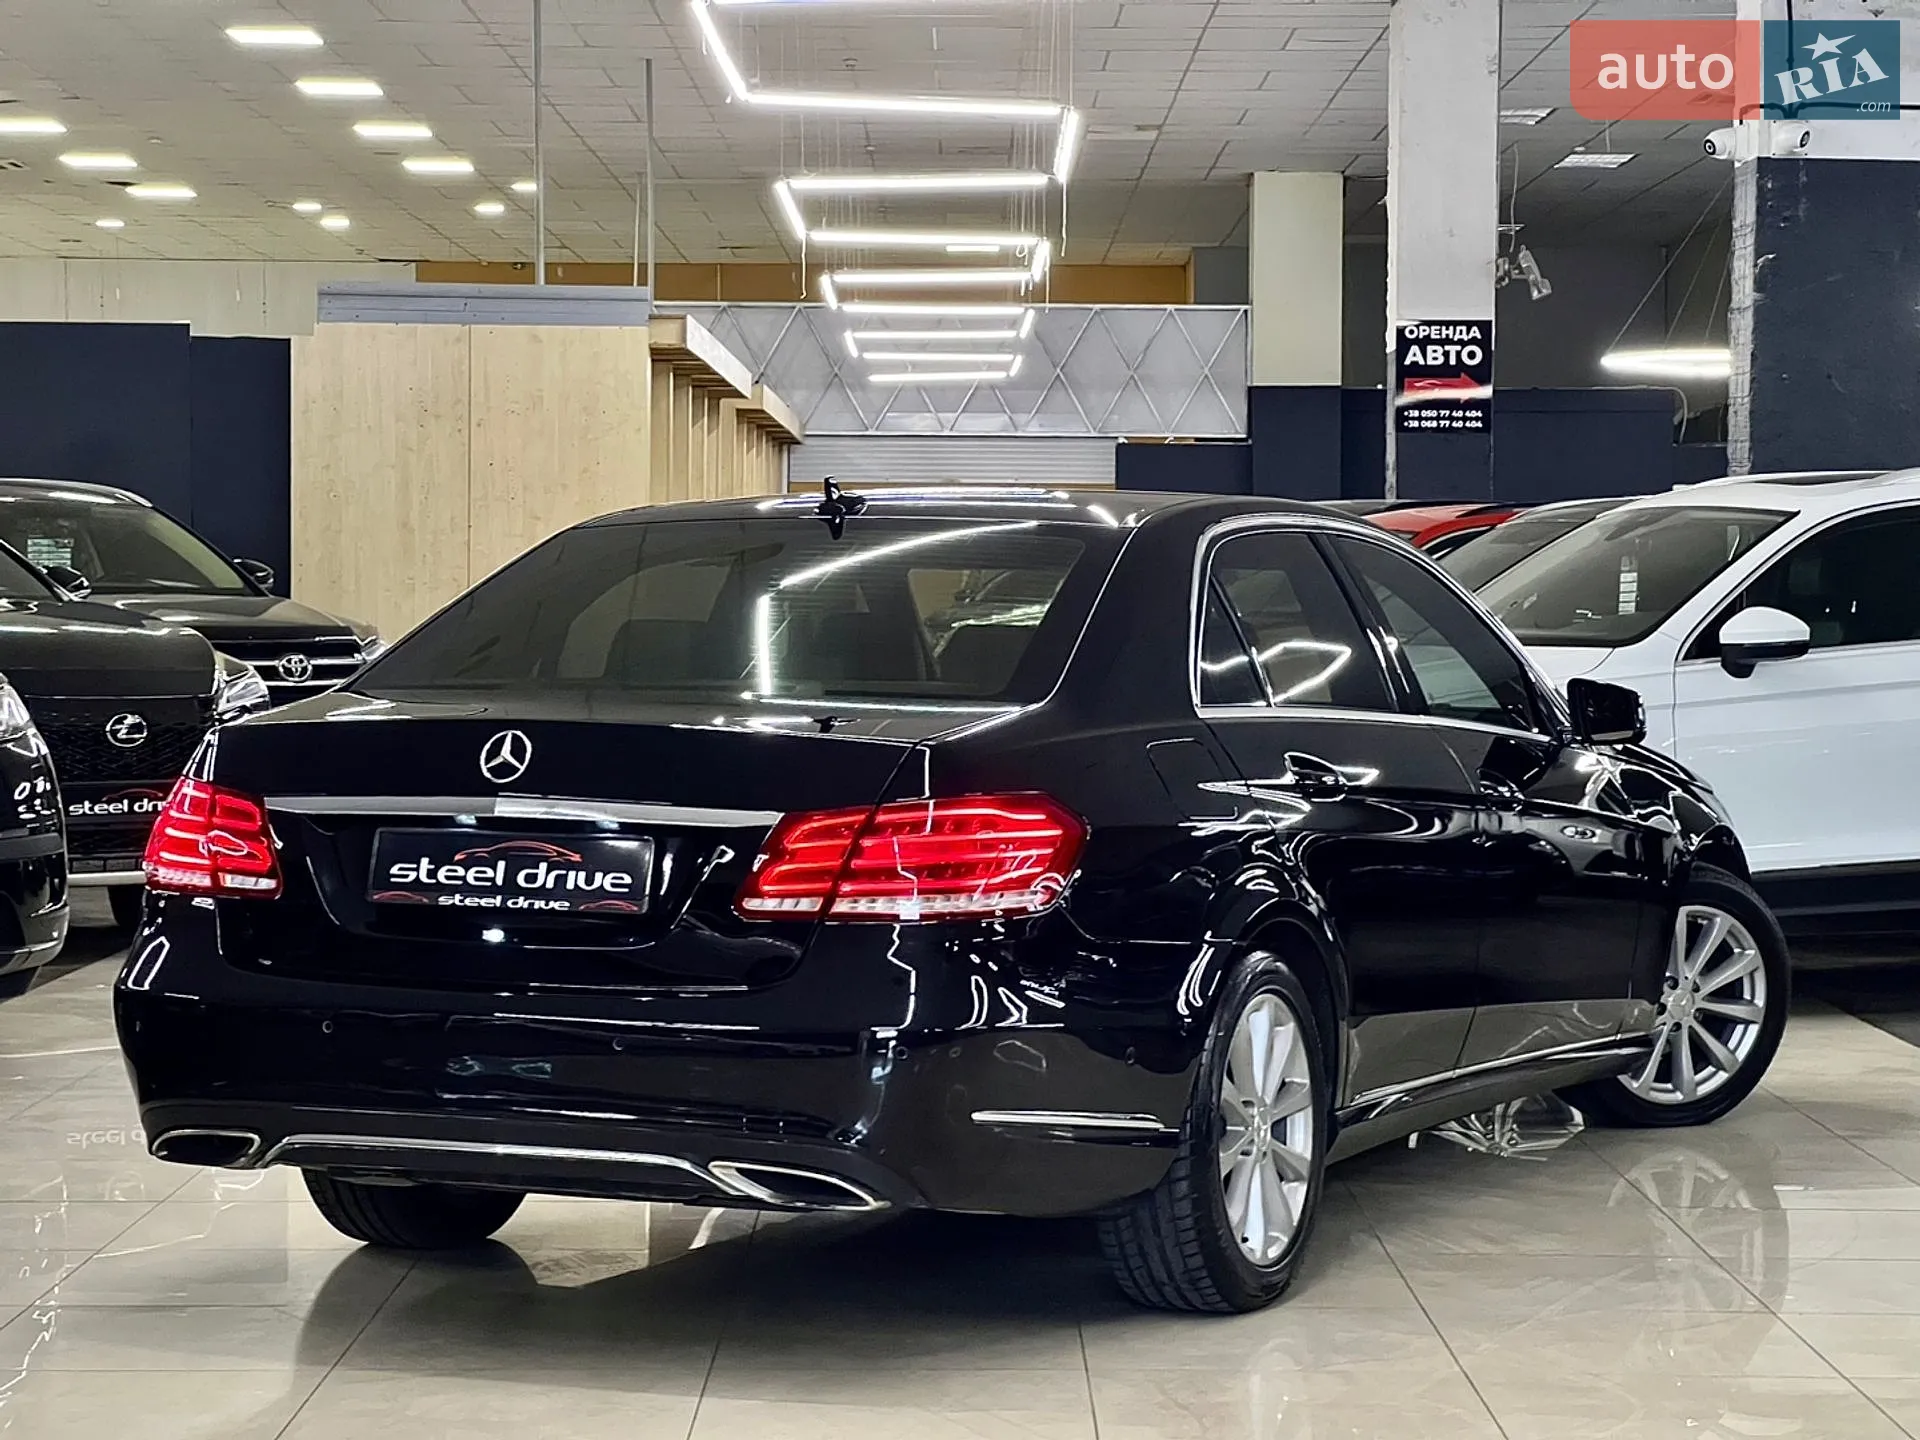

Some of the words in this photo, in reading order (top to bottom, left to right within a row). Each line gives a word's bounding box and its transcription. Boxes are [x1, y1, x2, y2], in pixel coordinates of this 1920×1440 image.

[1404, 325, 1481, 341] ОРЕНДА
[1404, 345, 1482, 366] АВТО
[1439, 409, 1450, 417] 77
[1451, 409, 1463, 417] 40
[1465, 409, 1483, 417] 404
[1439, 420, 1450, 428] 77
[1451, 420, 1463, 428] 40
[1465, 420, 1483, 428] 404
[68, 799, 128, 815] steel
[389, 857, 505, 886] steel
[515, 862, 633, 892] drive
[437, 895, 502, 907] steel
[506, 897, 571, 911] drive
